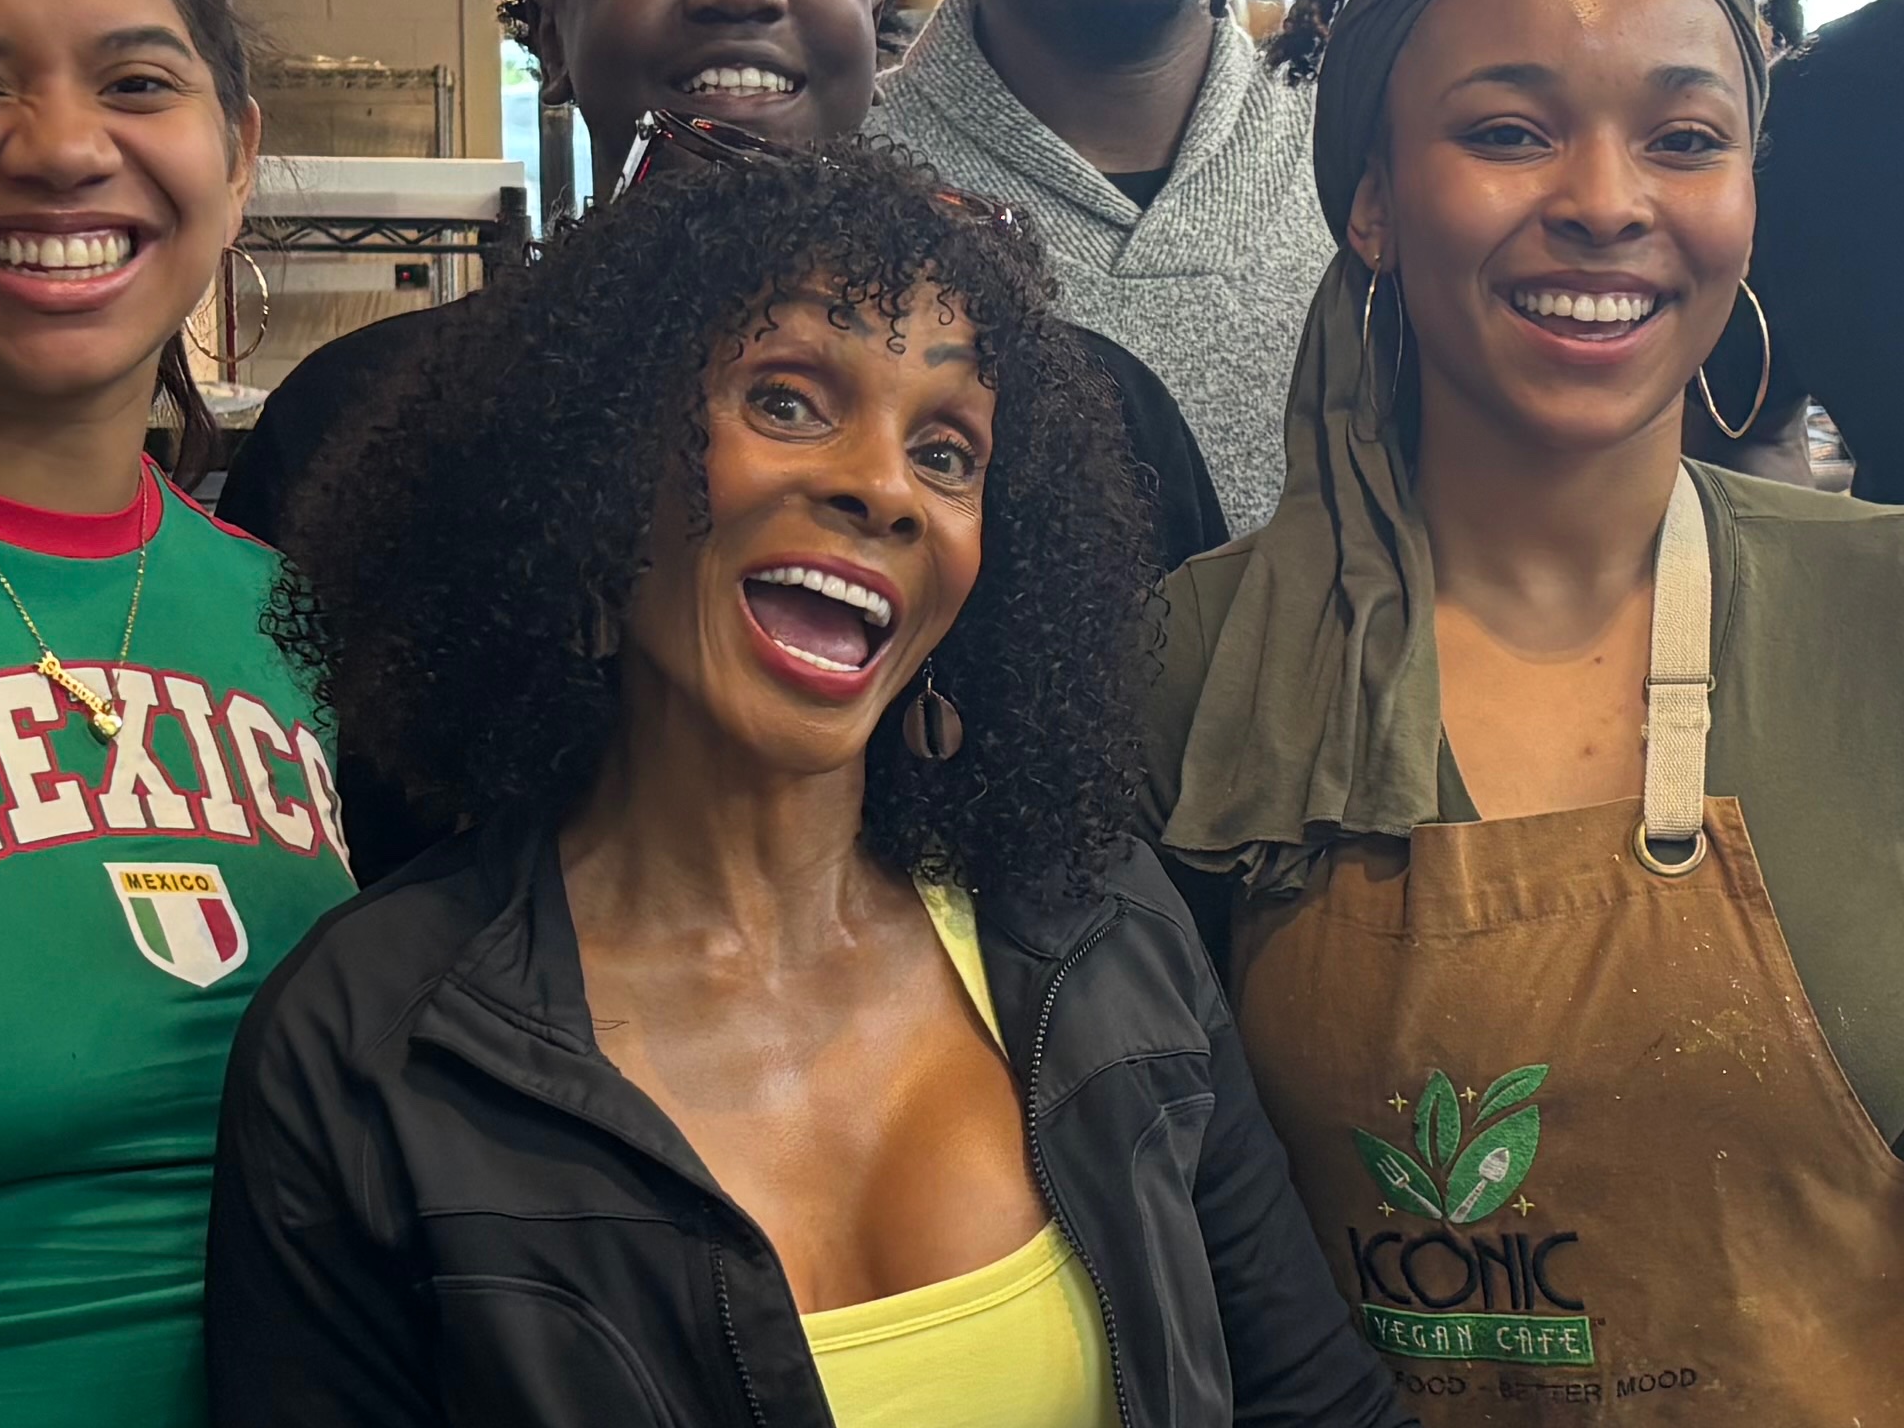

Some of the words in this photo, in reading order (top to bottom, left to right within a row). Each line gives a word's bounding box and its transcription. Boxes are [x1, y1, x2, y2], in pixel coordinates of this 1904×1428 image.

[124, 871, 210, 893] MEXICO
[1348, 1227, 1585, 1310] ICONIC
[1374, 1316, 1474, 1351] VEGAN
[1496, 1325, 1581, 1355] CAFE
[1615, 1367, 1698, 1398] MOOD
